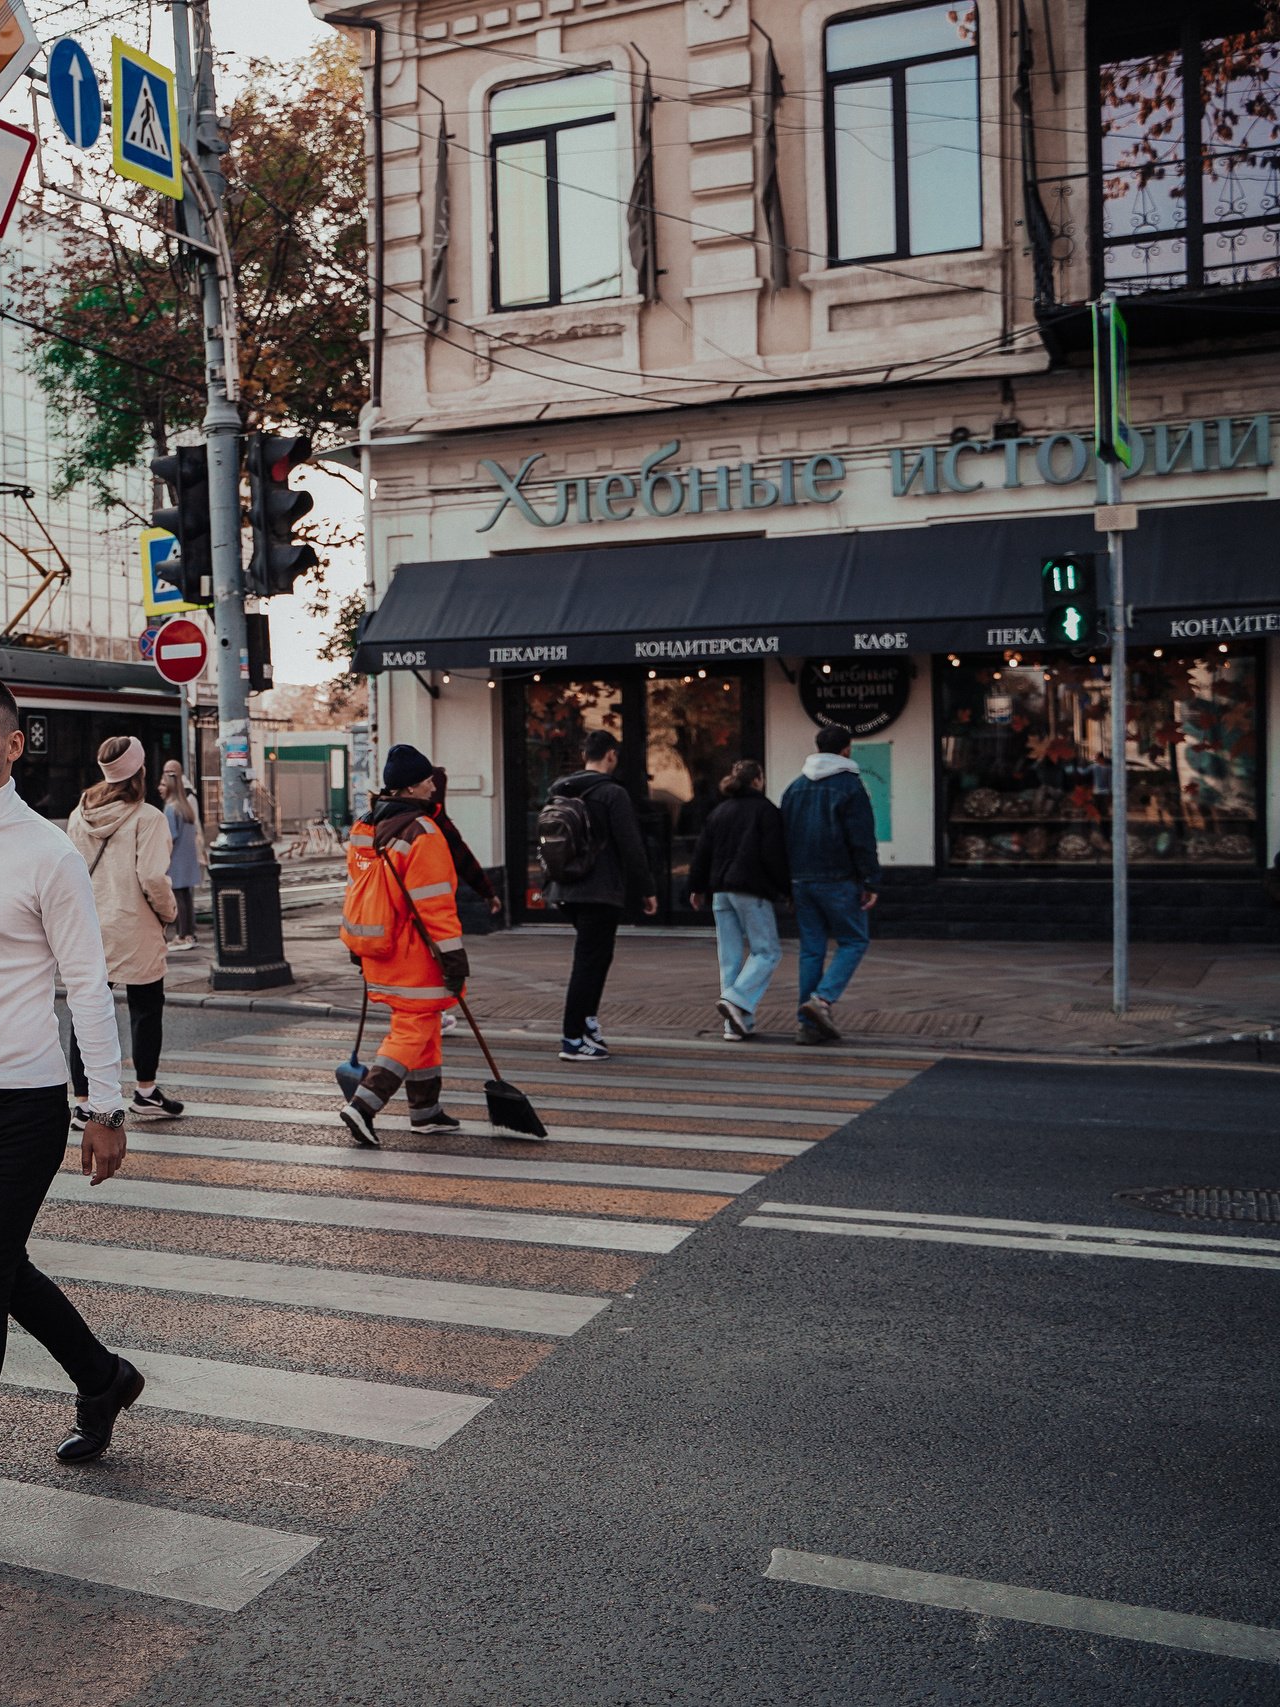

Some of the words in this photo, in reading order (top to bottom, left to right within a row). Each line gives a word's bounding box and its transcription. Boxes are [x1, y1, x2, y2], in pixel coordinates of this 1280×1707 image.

[475, 439, 846, 533] Хлебные
[889, 414, 1273, 504] истории
[382, 651, 426, 667] КАФЕ
[489, 646, 568, 663] ПЕКАРНЯ
[634, 636, 780, 659] КОНДИТЕРСКАЯ
[853, 632, 909, 650] КАФЕ
[987, 627, 1046, 646] ПЕКА
